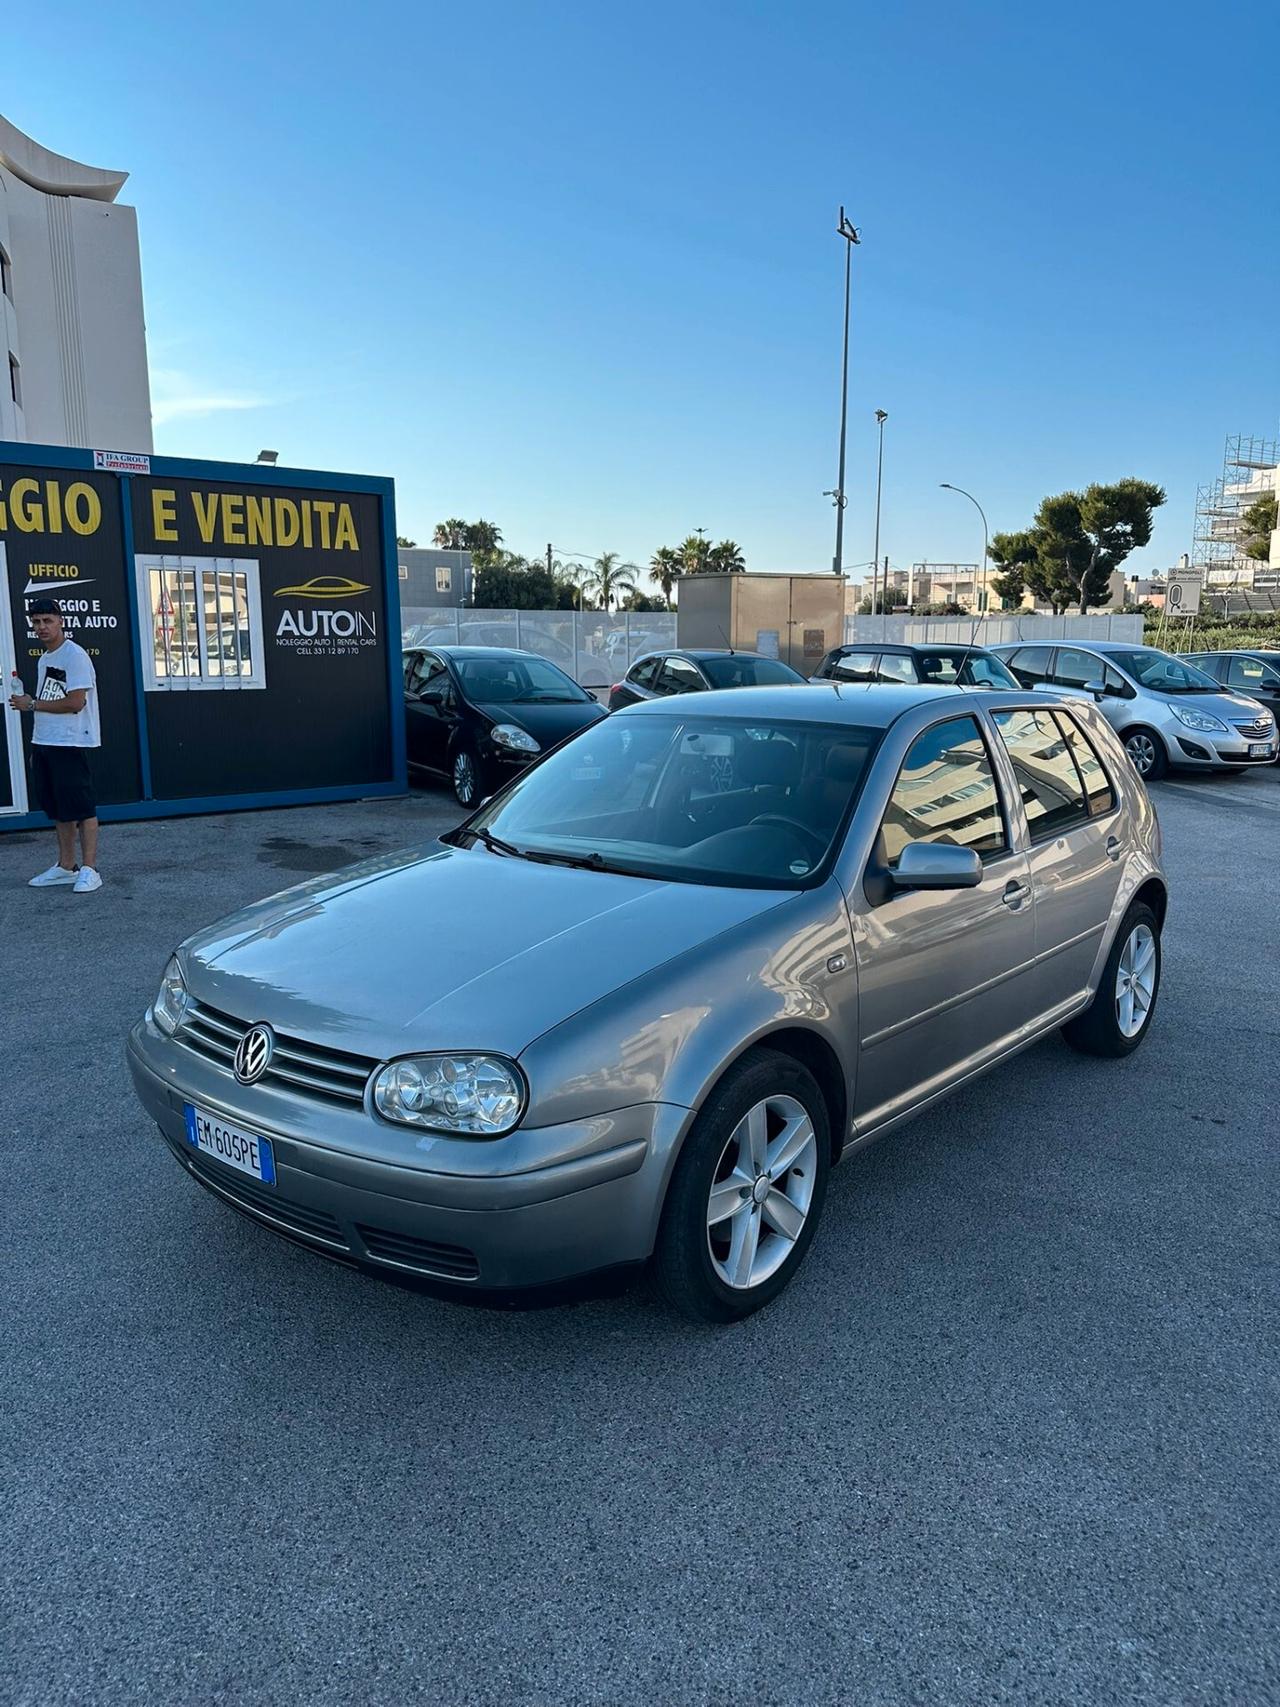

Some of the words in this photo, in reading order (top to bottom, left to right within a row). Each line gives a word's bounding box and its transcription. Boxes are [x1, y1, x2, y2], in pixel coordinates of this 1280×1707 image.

[120, 455, 149, 464] GROUP
[0, 478, 101, 535] GIO
[152, 489, 178, 541] E
[191, 491, 360, 551] VENDITA
[29, 563, 79, 577] UFFICIO
[92, 600, 101, 612] E
[85, 616, 117, 628] AUTO
[276, 638, 313, 646] NOLEGGIO
[336, 638, 359, 646] RENTAL
[360, 638, 377, 646] CARS
[296, 647, 312, 655] CELL
[313, 647, 326, 655] 331
[328, 647, 336, 655] 12
[337, 647, 346, 655] 89
[347, 647, 359, 655] 170
